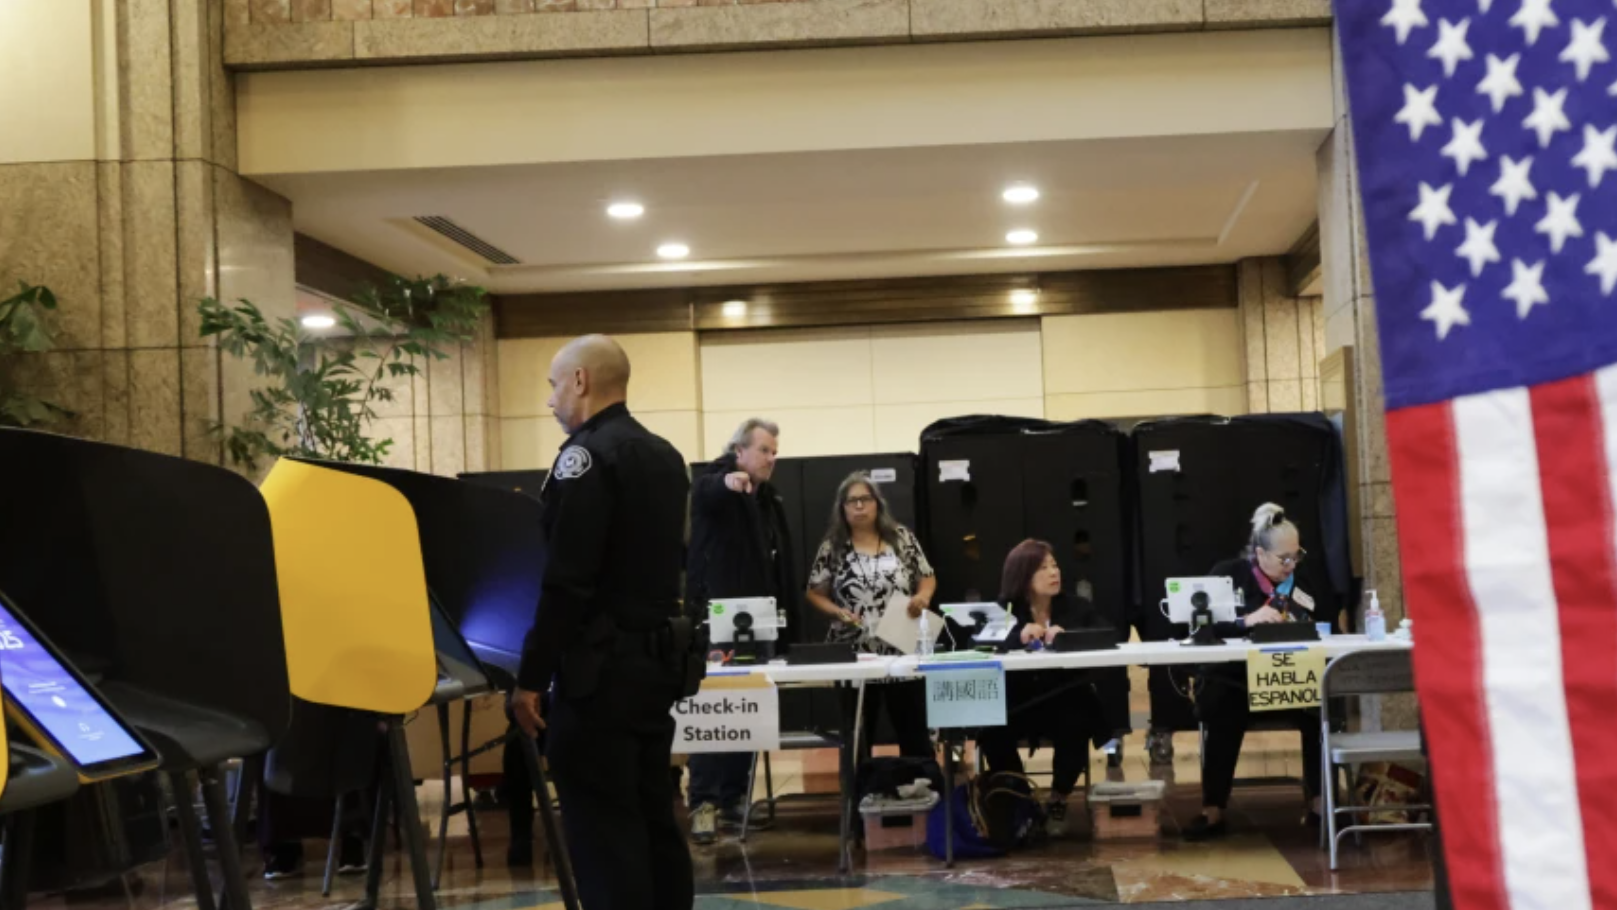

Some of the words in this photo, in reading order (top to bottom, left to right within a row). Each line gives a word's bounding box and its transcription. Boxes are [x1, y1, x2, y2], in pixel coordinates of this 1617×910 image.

[1272, 652, 1295, 667] SE
[1256, 670, 1317, 687] HABLA
[675, 698, 758, 714] Check-in
[683, 725, 751, 741] Station
